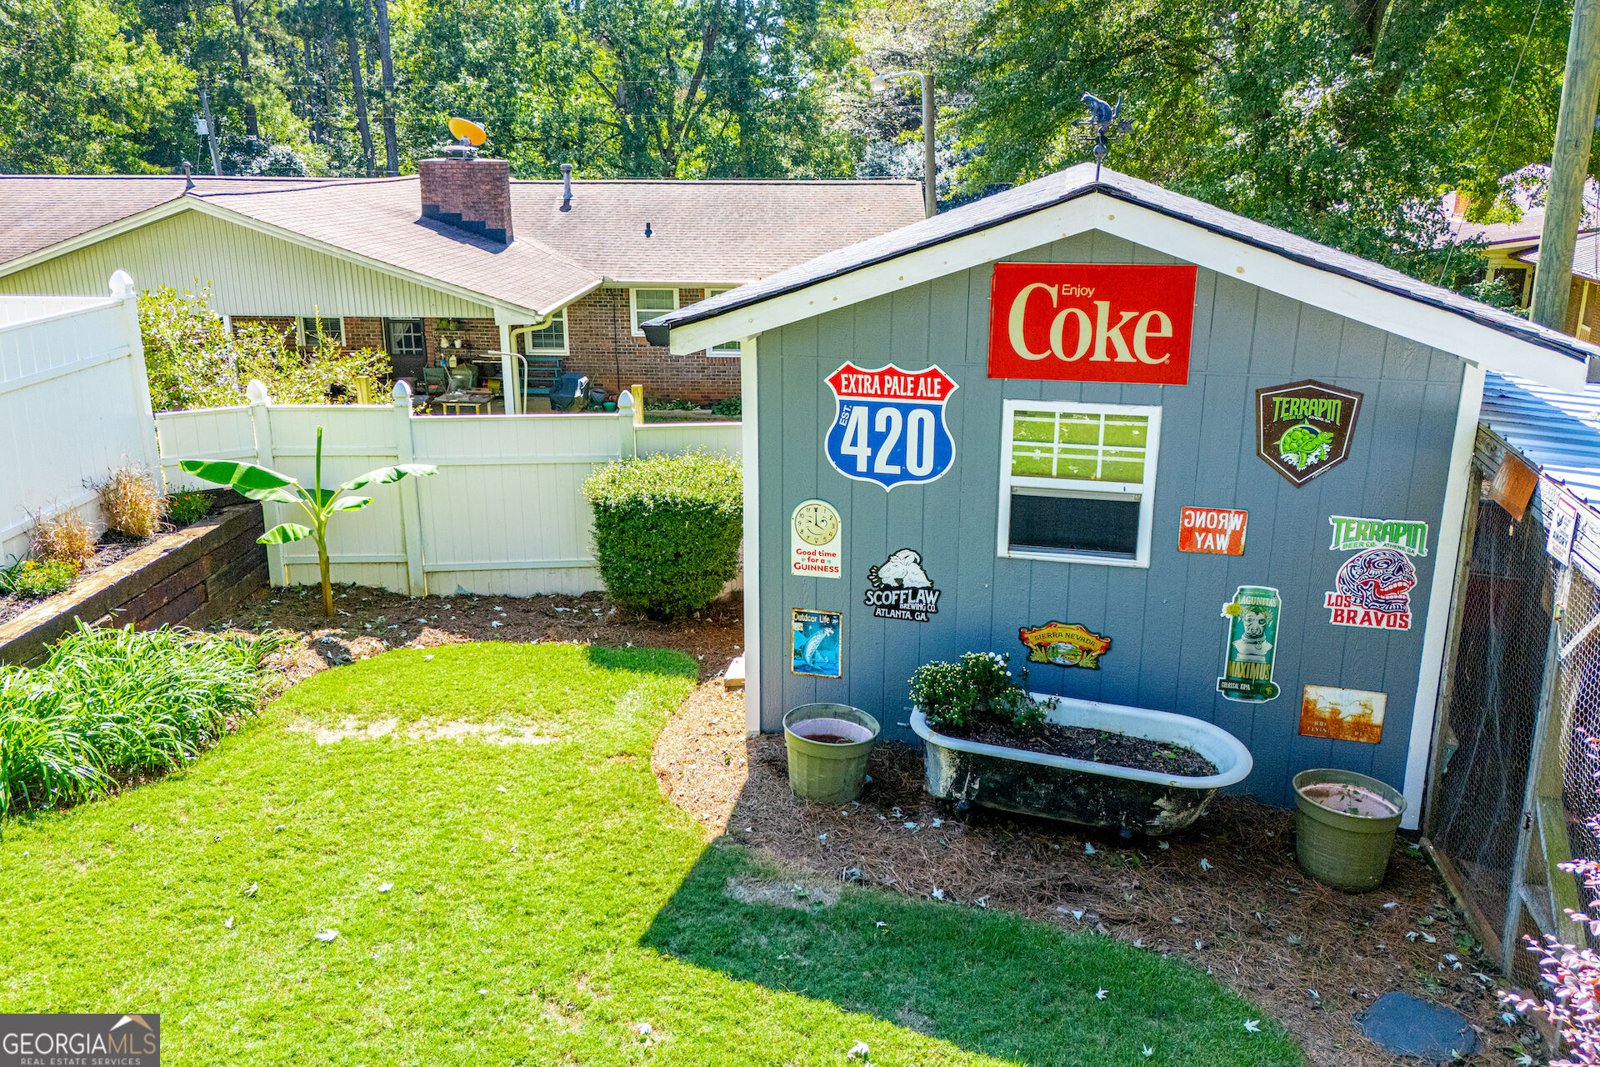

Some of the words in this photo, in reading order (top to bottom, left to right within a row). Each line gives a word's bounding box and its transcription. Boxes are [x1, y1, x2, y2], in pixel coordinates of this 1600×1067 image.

[1061, 284, 1095, 297] Enjoy
[1008, 282, 1173, 365] Coke
[840, 373, 881, 395] EXTRA
[883, 375, 914, 397] PALE
[916, 377, 942, 398] ALE
[838, 404, 852, 427] EST.
[1272, 396, 1342, 426] TERRAPIN
[840, 405, 936, 477] 420
[1331, 517, 1428, 556] TERRAPIN
[795, 548, 817, 557] Good
[818, 550, 837, 558] time
[1342, 541, 1365, 550] BEER
[793, 561, 840, 574] GUINNESS
[865, 589, 940, 606] SCOFFLAW
[1326, 593, 1352, 608] LOS
[899, 602, 926, 612] BREWING
[793, 612, 818, 623] Outdoor
[819, 614, 831, 624] Life
[1332, 608, 1410, 630] BRAVOS
[1034, 631, 1063, 642] SIERRA
[1064, 632, 1096, 647] NEVADA
[1227, 660, 1271, 681] MAXIMUS
